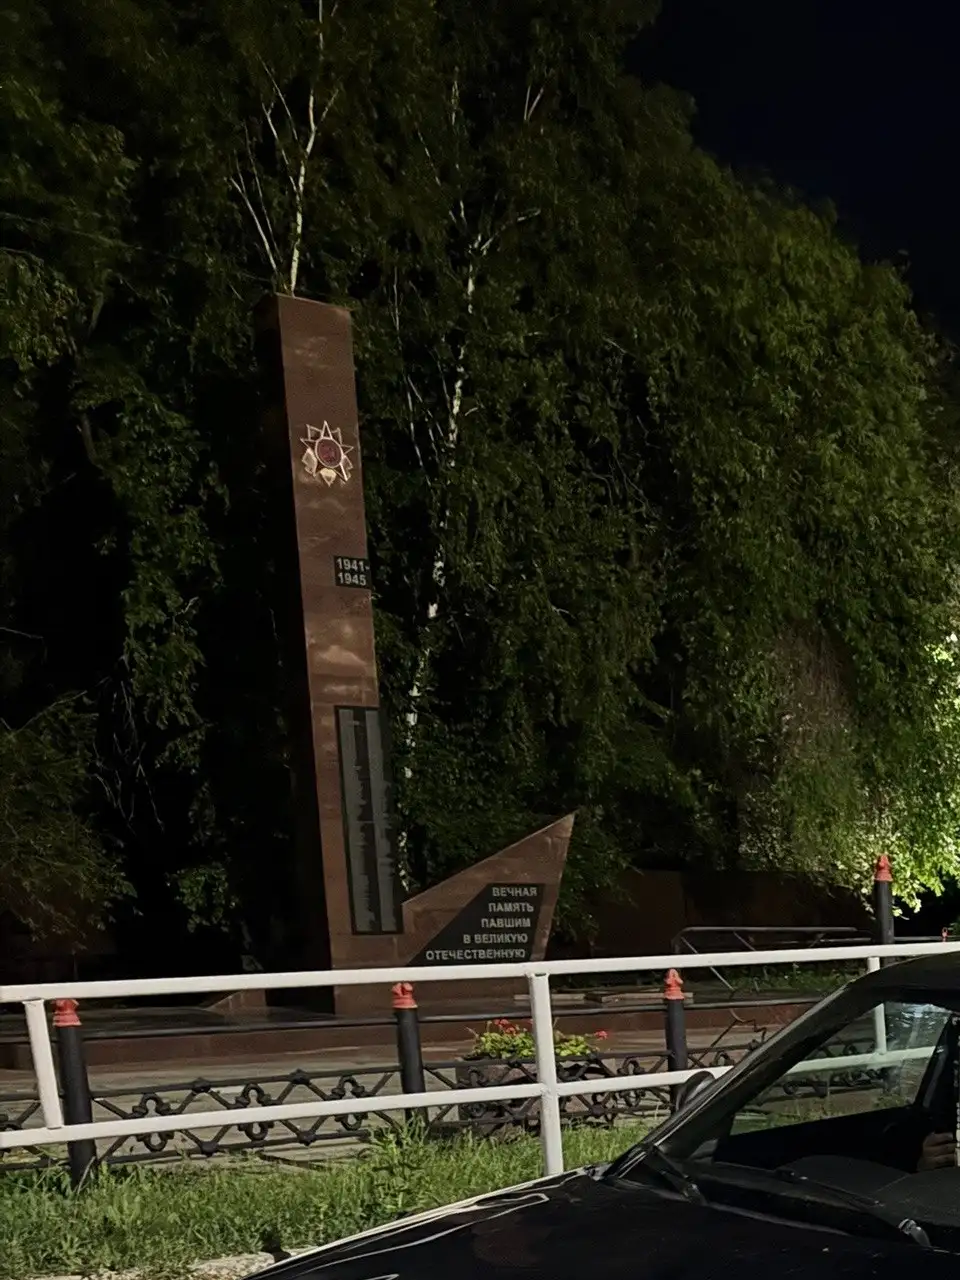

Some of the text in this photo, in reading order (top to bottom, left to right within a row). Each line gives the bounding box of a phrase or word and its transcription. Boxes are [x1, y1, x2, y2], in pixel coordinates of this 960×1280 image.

[337, 572, 367, 586] 1945
[492, 887, 538, 897] ВЕЧНАЯ
[488, 903, 534, 913] ПАМЯТЬ
[481, 918, 531, 929] ПАВШИМ
[463, 933, 528, 944] В ВЕЛИКУЮ
[425, 949, 526, 961] ОТЕЧЕСТВЕННУЮ
